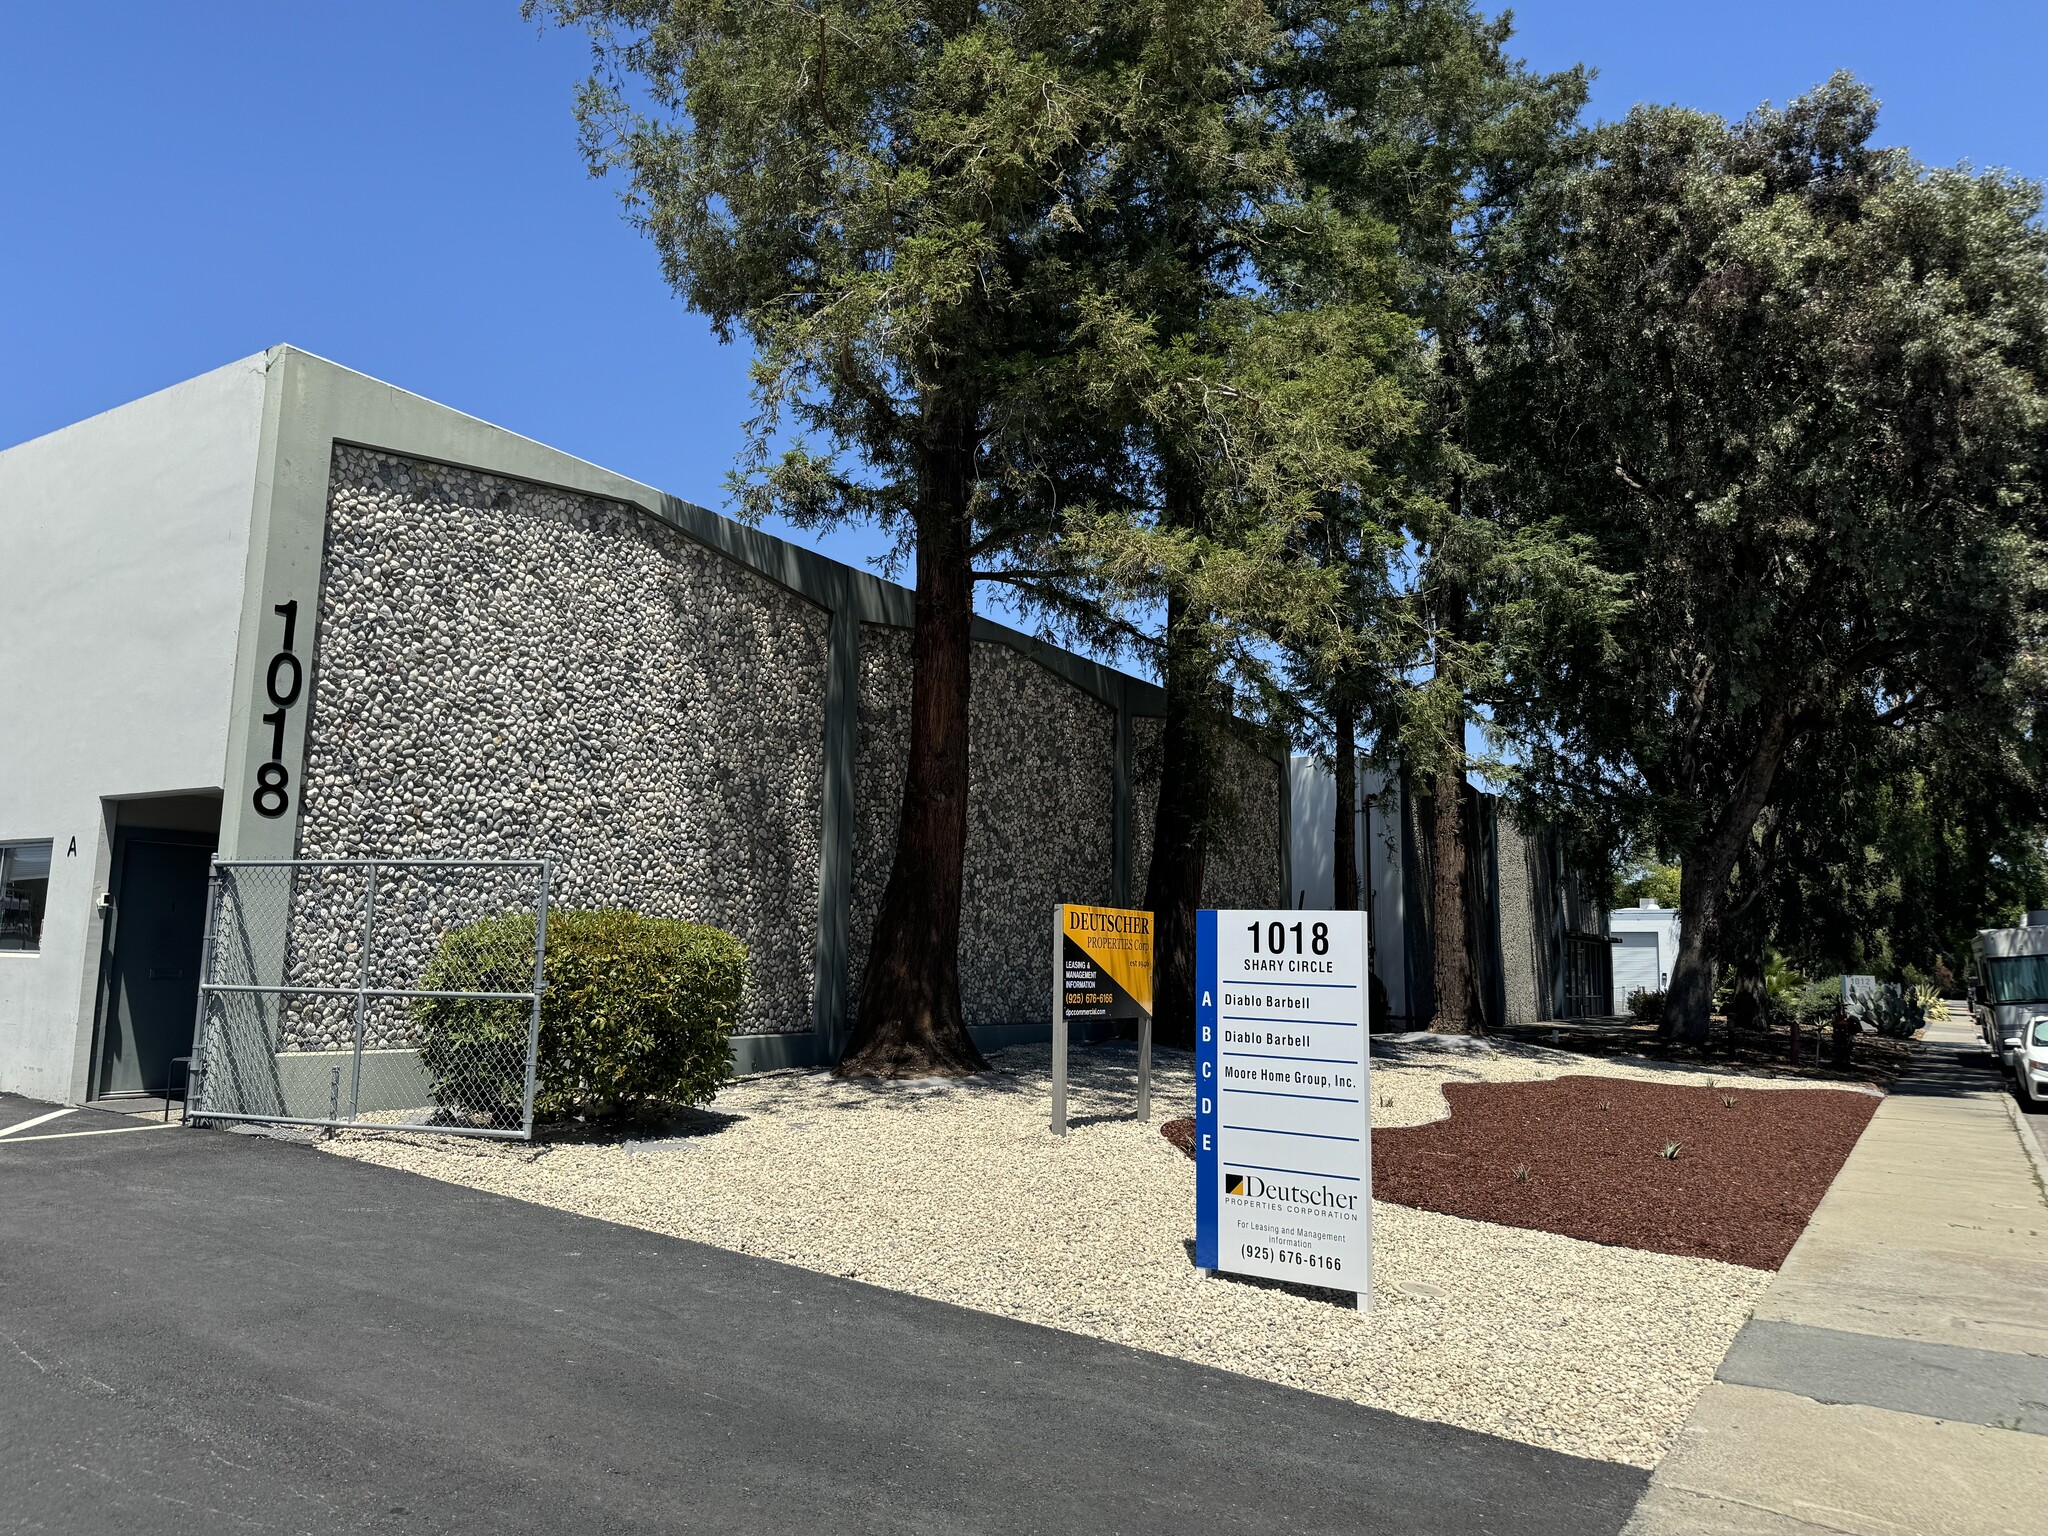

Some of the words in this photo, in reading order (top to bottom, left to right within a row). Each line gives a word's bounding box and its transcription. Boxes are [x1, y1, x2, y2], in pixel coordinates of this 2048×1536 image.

[252, 599, 303, 820] 1018
[67, 836, 77, 857] A
[1069, 911, 1150, 935] DEUTSCHER
[1087, 936, 1133, 951] PROPERTIES
[1247, 921, 1329, 955] 1018
[1065, 960, 1086, 969] LEASING
[1086, 961, 1091, 969] &
[1244, 959, 1284, 972] SHARY
[1288, 960, 1333, 973] CIRCLE
[1065, 970, 1097, 979] MANAGEMENT
[1065, 980, 1096, 989] INFORMATION
[1065, 992, 1084, 1005] (925)
[1085, 993, 1113, 1004] 676-6166
[1202, 991, 1212, 1007] A
[1224, 994, 1262, 1007] Diablo
[1266, 996, 1310, 1009] Barbell
[1202, 1026, 1212, 1042] B
[1224, 1030, 1262, 1044] Diablo
[1266, 1033, 1310, 1047] Barbell
[1202, 1061, 1212, 1078] C
[1224, 1066, 1257, 1080] Moore
[1261, 1069, 1291, 1083] Home
[1294, 1071, 1331, 1088] Group,
[1335, 1074, 1356, 1088] Inc.
[1202, 1097, 1212, 1114] D
[1202, 1134, 1211, 1151] E
[1245, 1175, 1358, 1210] Deutscher
[1225, 1197, 1283, 1211] PROPERTIES
[1287, 1205, 1358, 1222] CORPORATION
[1237, 1219, 1249, 1229] For
[1250, 1221, 1279, 1235] Leasing
[1281, 1225, 1295, 1236] and
[1296, 1228, 1346, 1243] Management
[1241, 1244, 1274, 1264] (925)
[1279, 1249, 1341, 1271] 676-6166
